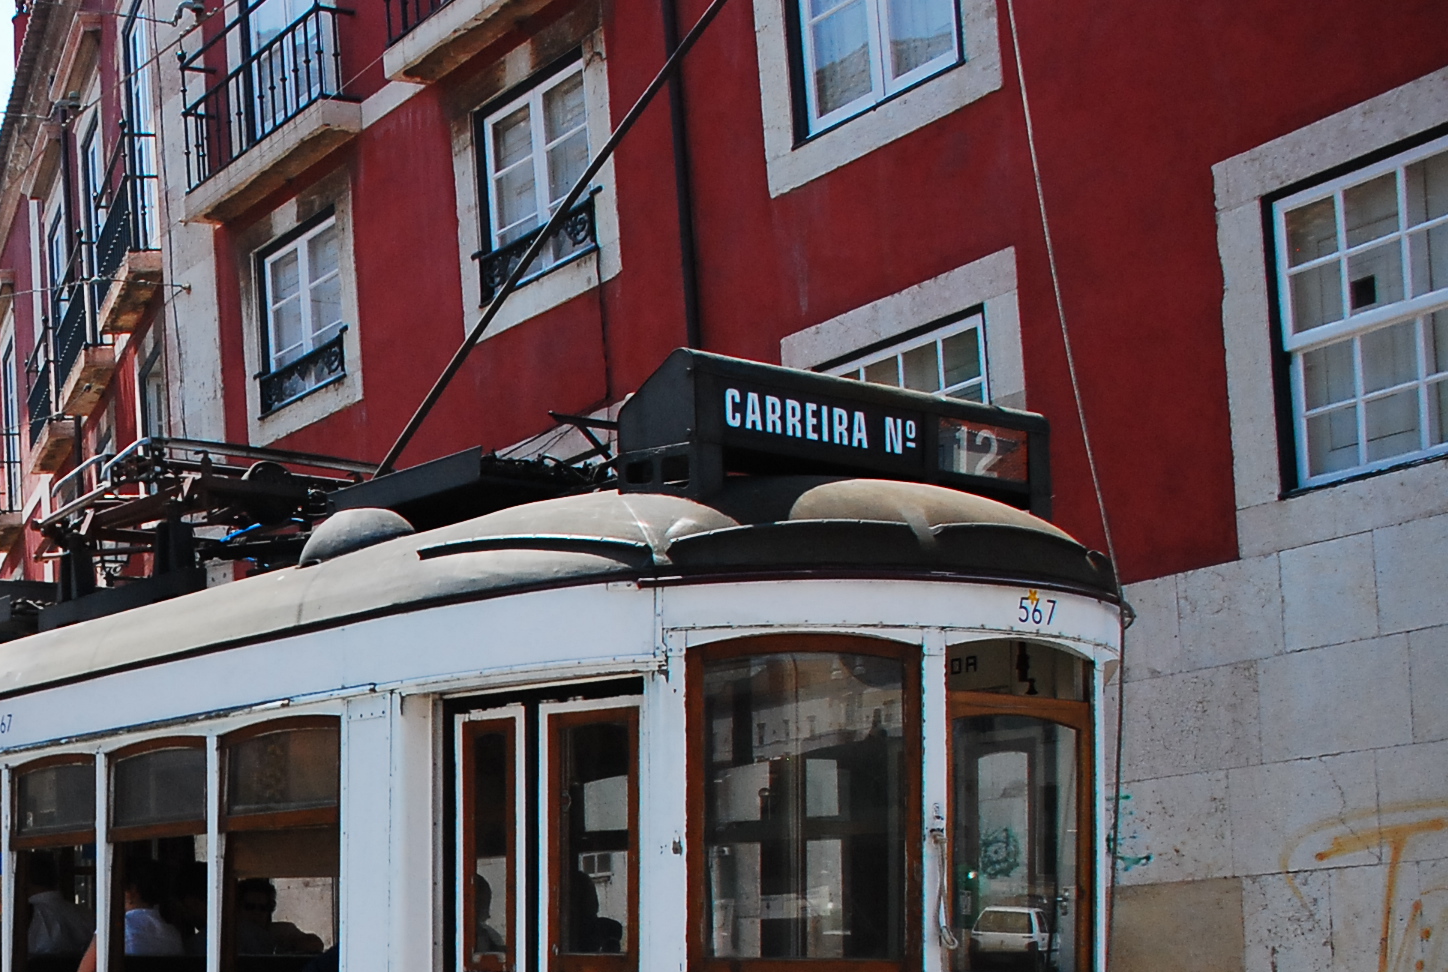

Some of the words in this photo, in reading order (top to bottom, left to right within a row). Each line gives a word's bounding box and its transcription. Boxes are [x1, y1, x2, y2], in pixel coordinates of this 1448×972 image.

[725, 387, 869, 449] CARREIRA
[955, 425, 998, 478] 12
[1019, 596, 1057, 625] 567
